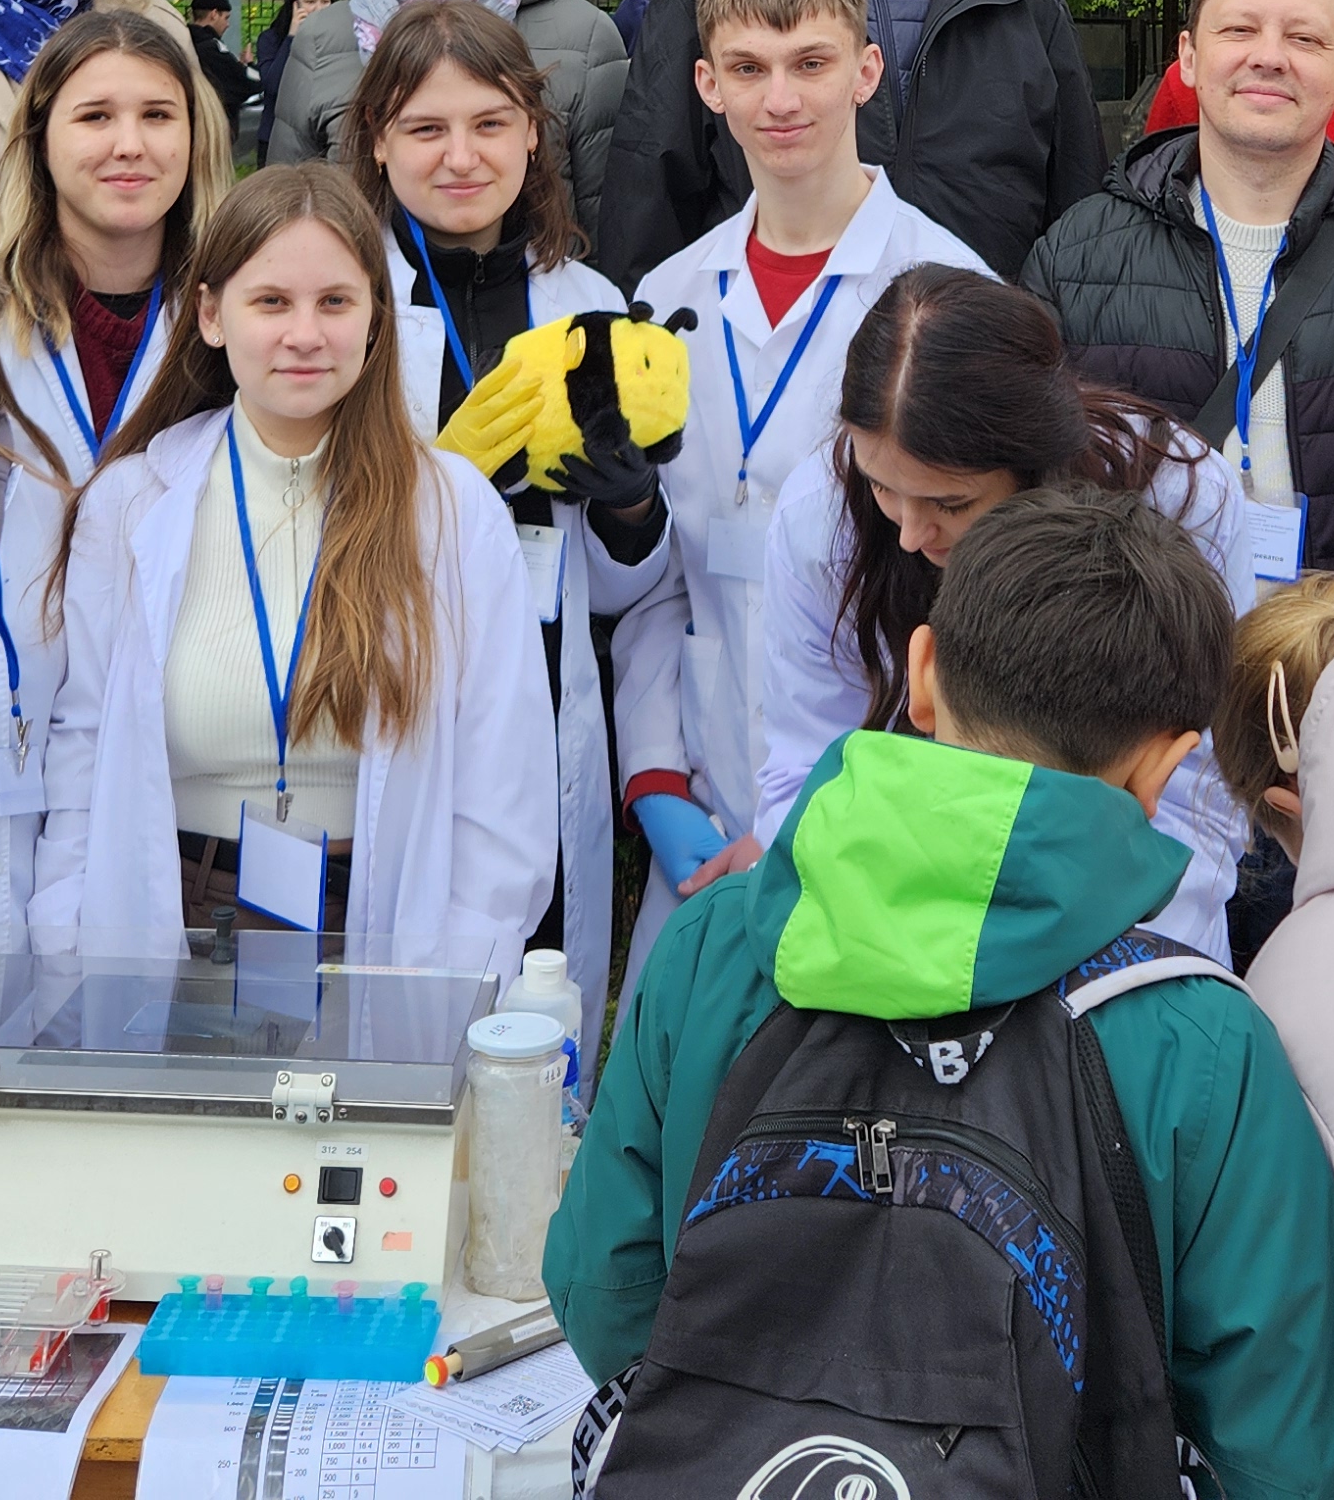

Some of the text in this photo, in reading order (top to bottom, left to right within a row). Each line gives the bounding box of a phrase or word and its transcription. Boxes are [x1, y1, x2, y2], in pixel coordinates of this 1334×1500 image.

[321, 1145, 362, 1155] 312 254
[328, 1443, 345, 1451] 1,000
[218, 1460, 231, 1468] 250
[326, 1457, 338, 1465] 750
[387, 1456, 398, 1464] 100
[294, 1469, 307, 1477] 200
[324, 1473, 336, 1482] 500
[323, 1490, 335, 1499] 250
